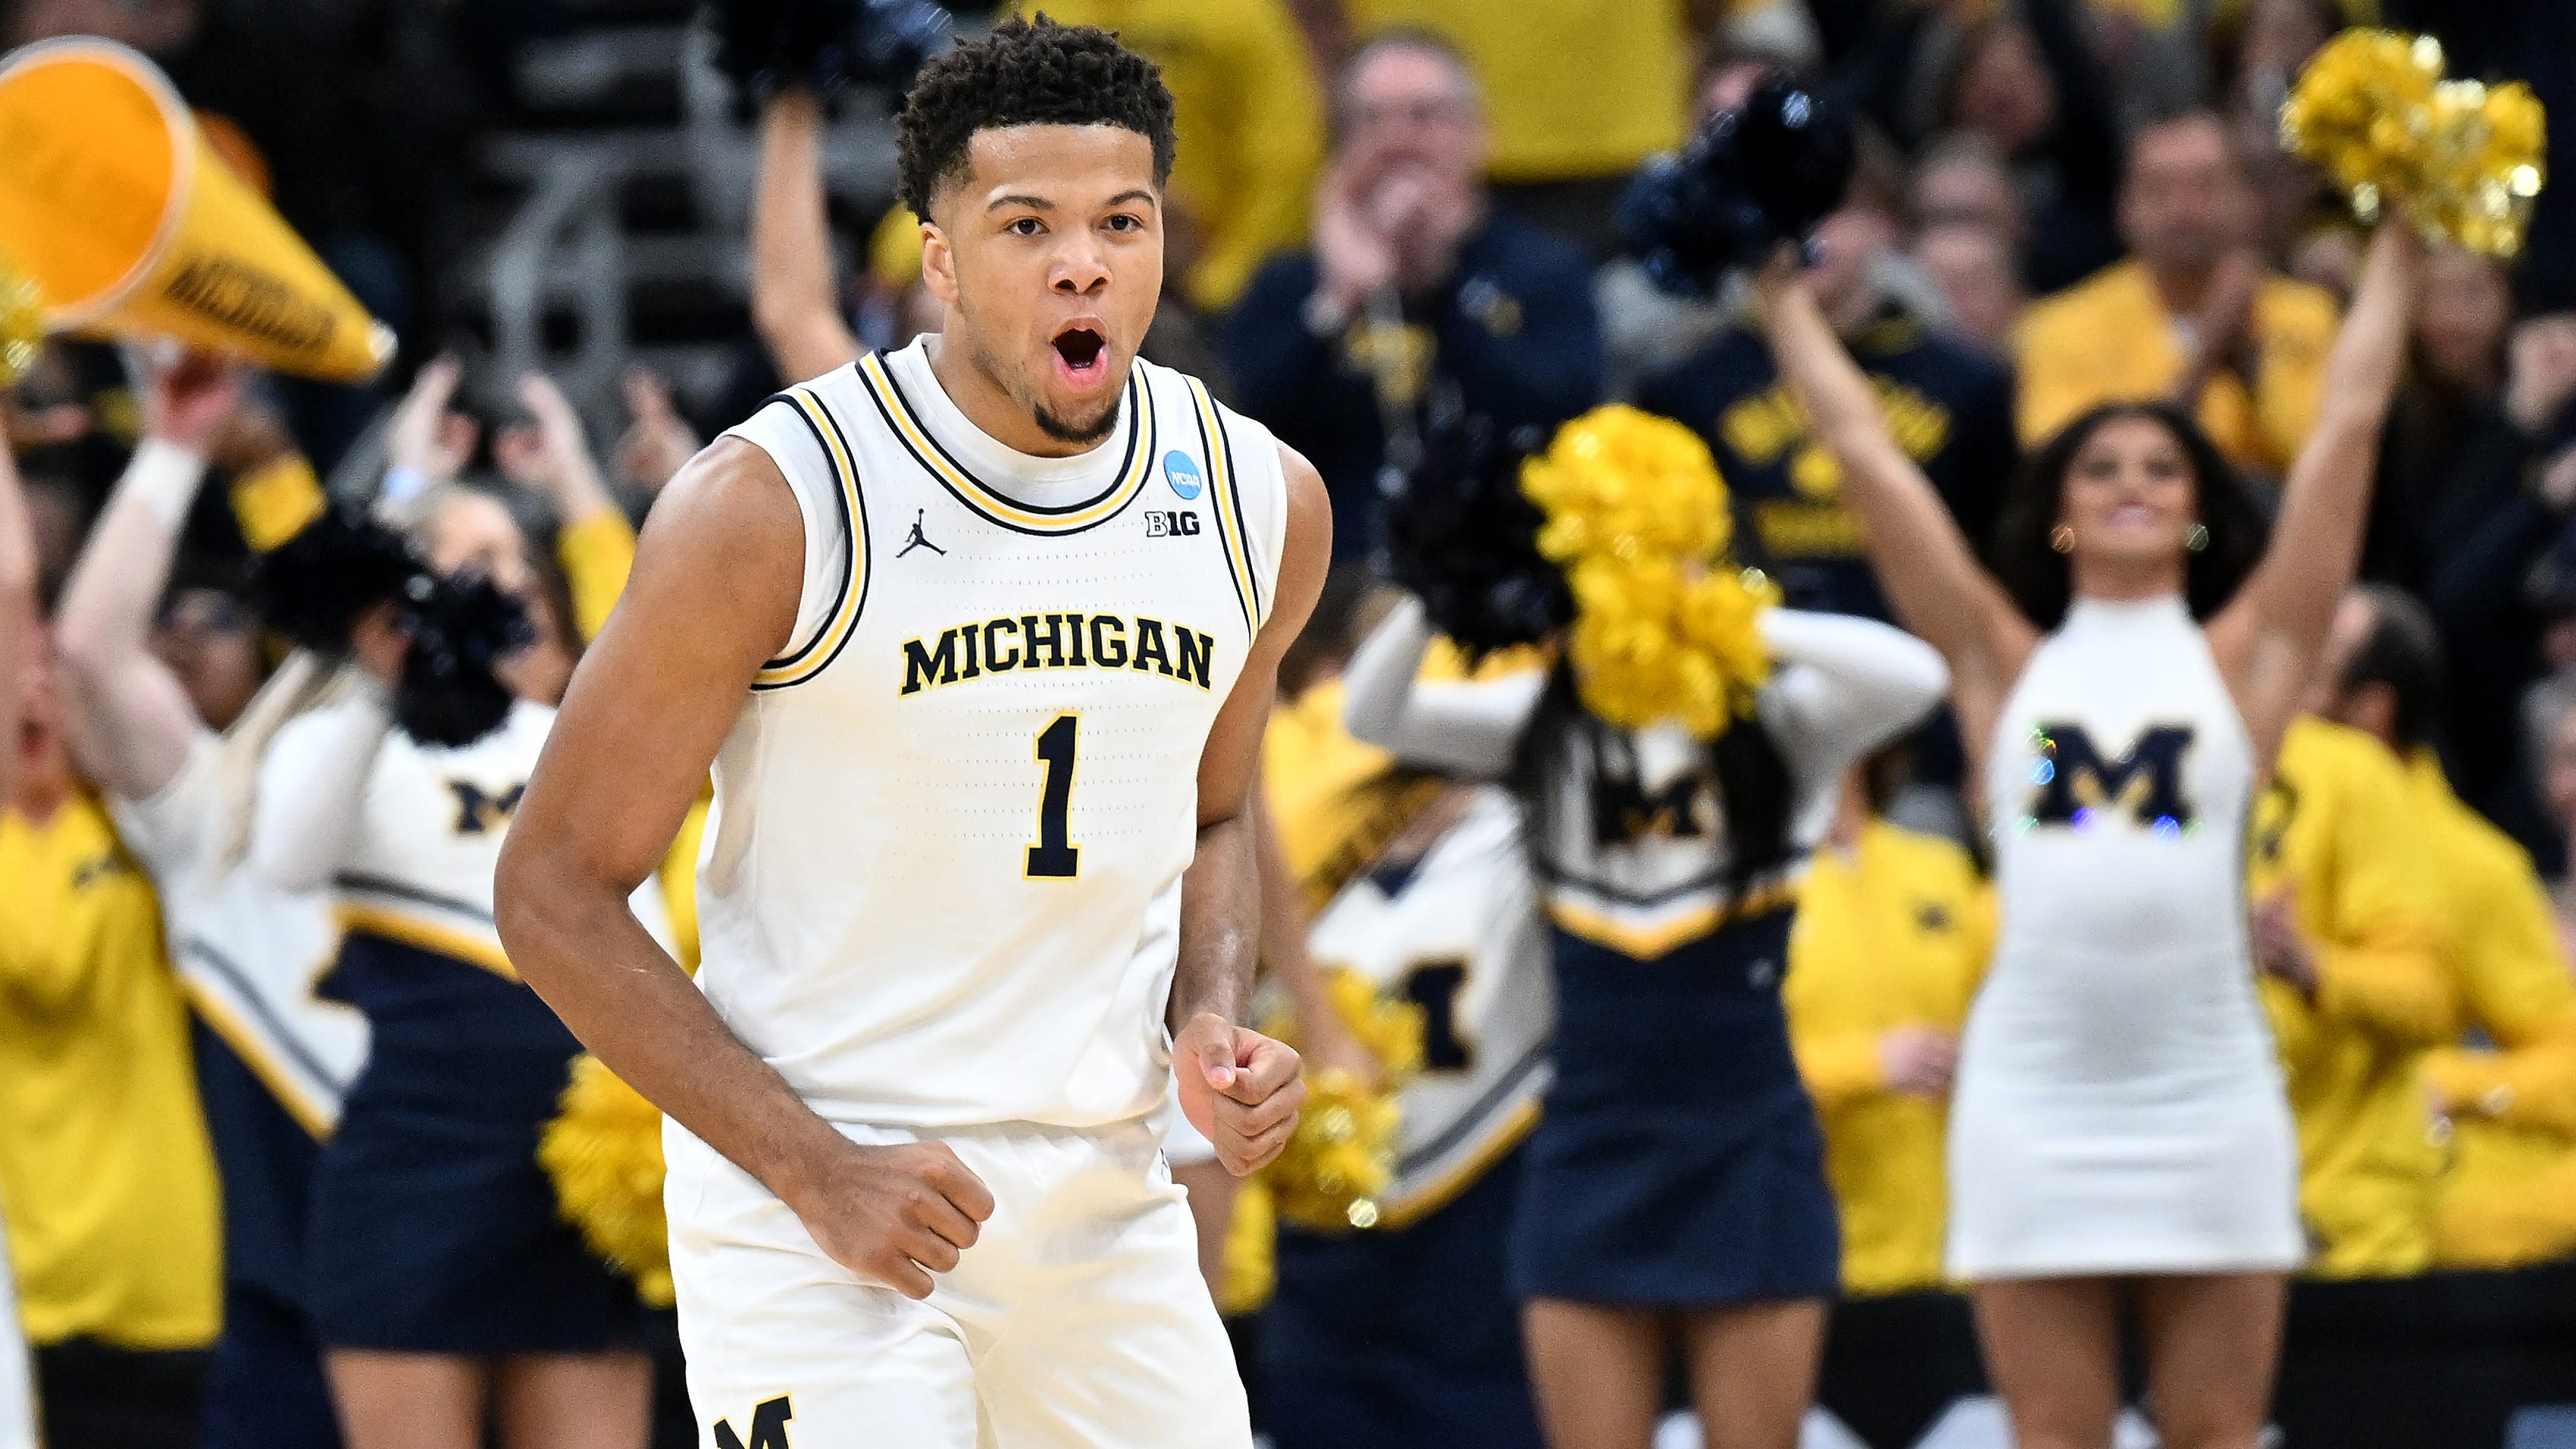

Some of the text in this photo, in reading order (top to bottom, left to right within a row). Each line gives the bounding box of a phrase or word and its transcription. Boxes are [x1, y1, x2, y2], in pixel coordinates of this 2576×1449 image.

[1170, 471, 1200, 488] NCAA
[900, 613, 1214, 696] MICHIGAN
[1023, 711, 1081, 880] 1
[2030, 720, 2196, 826] M
